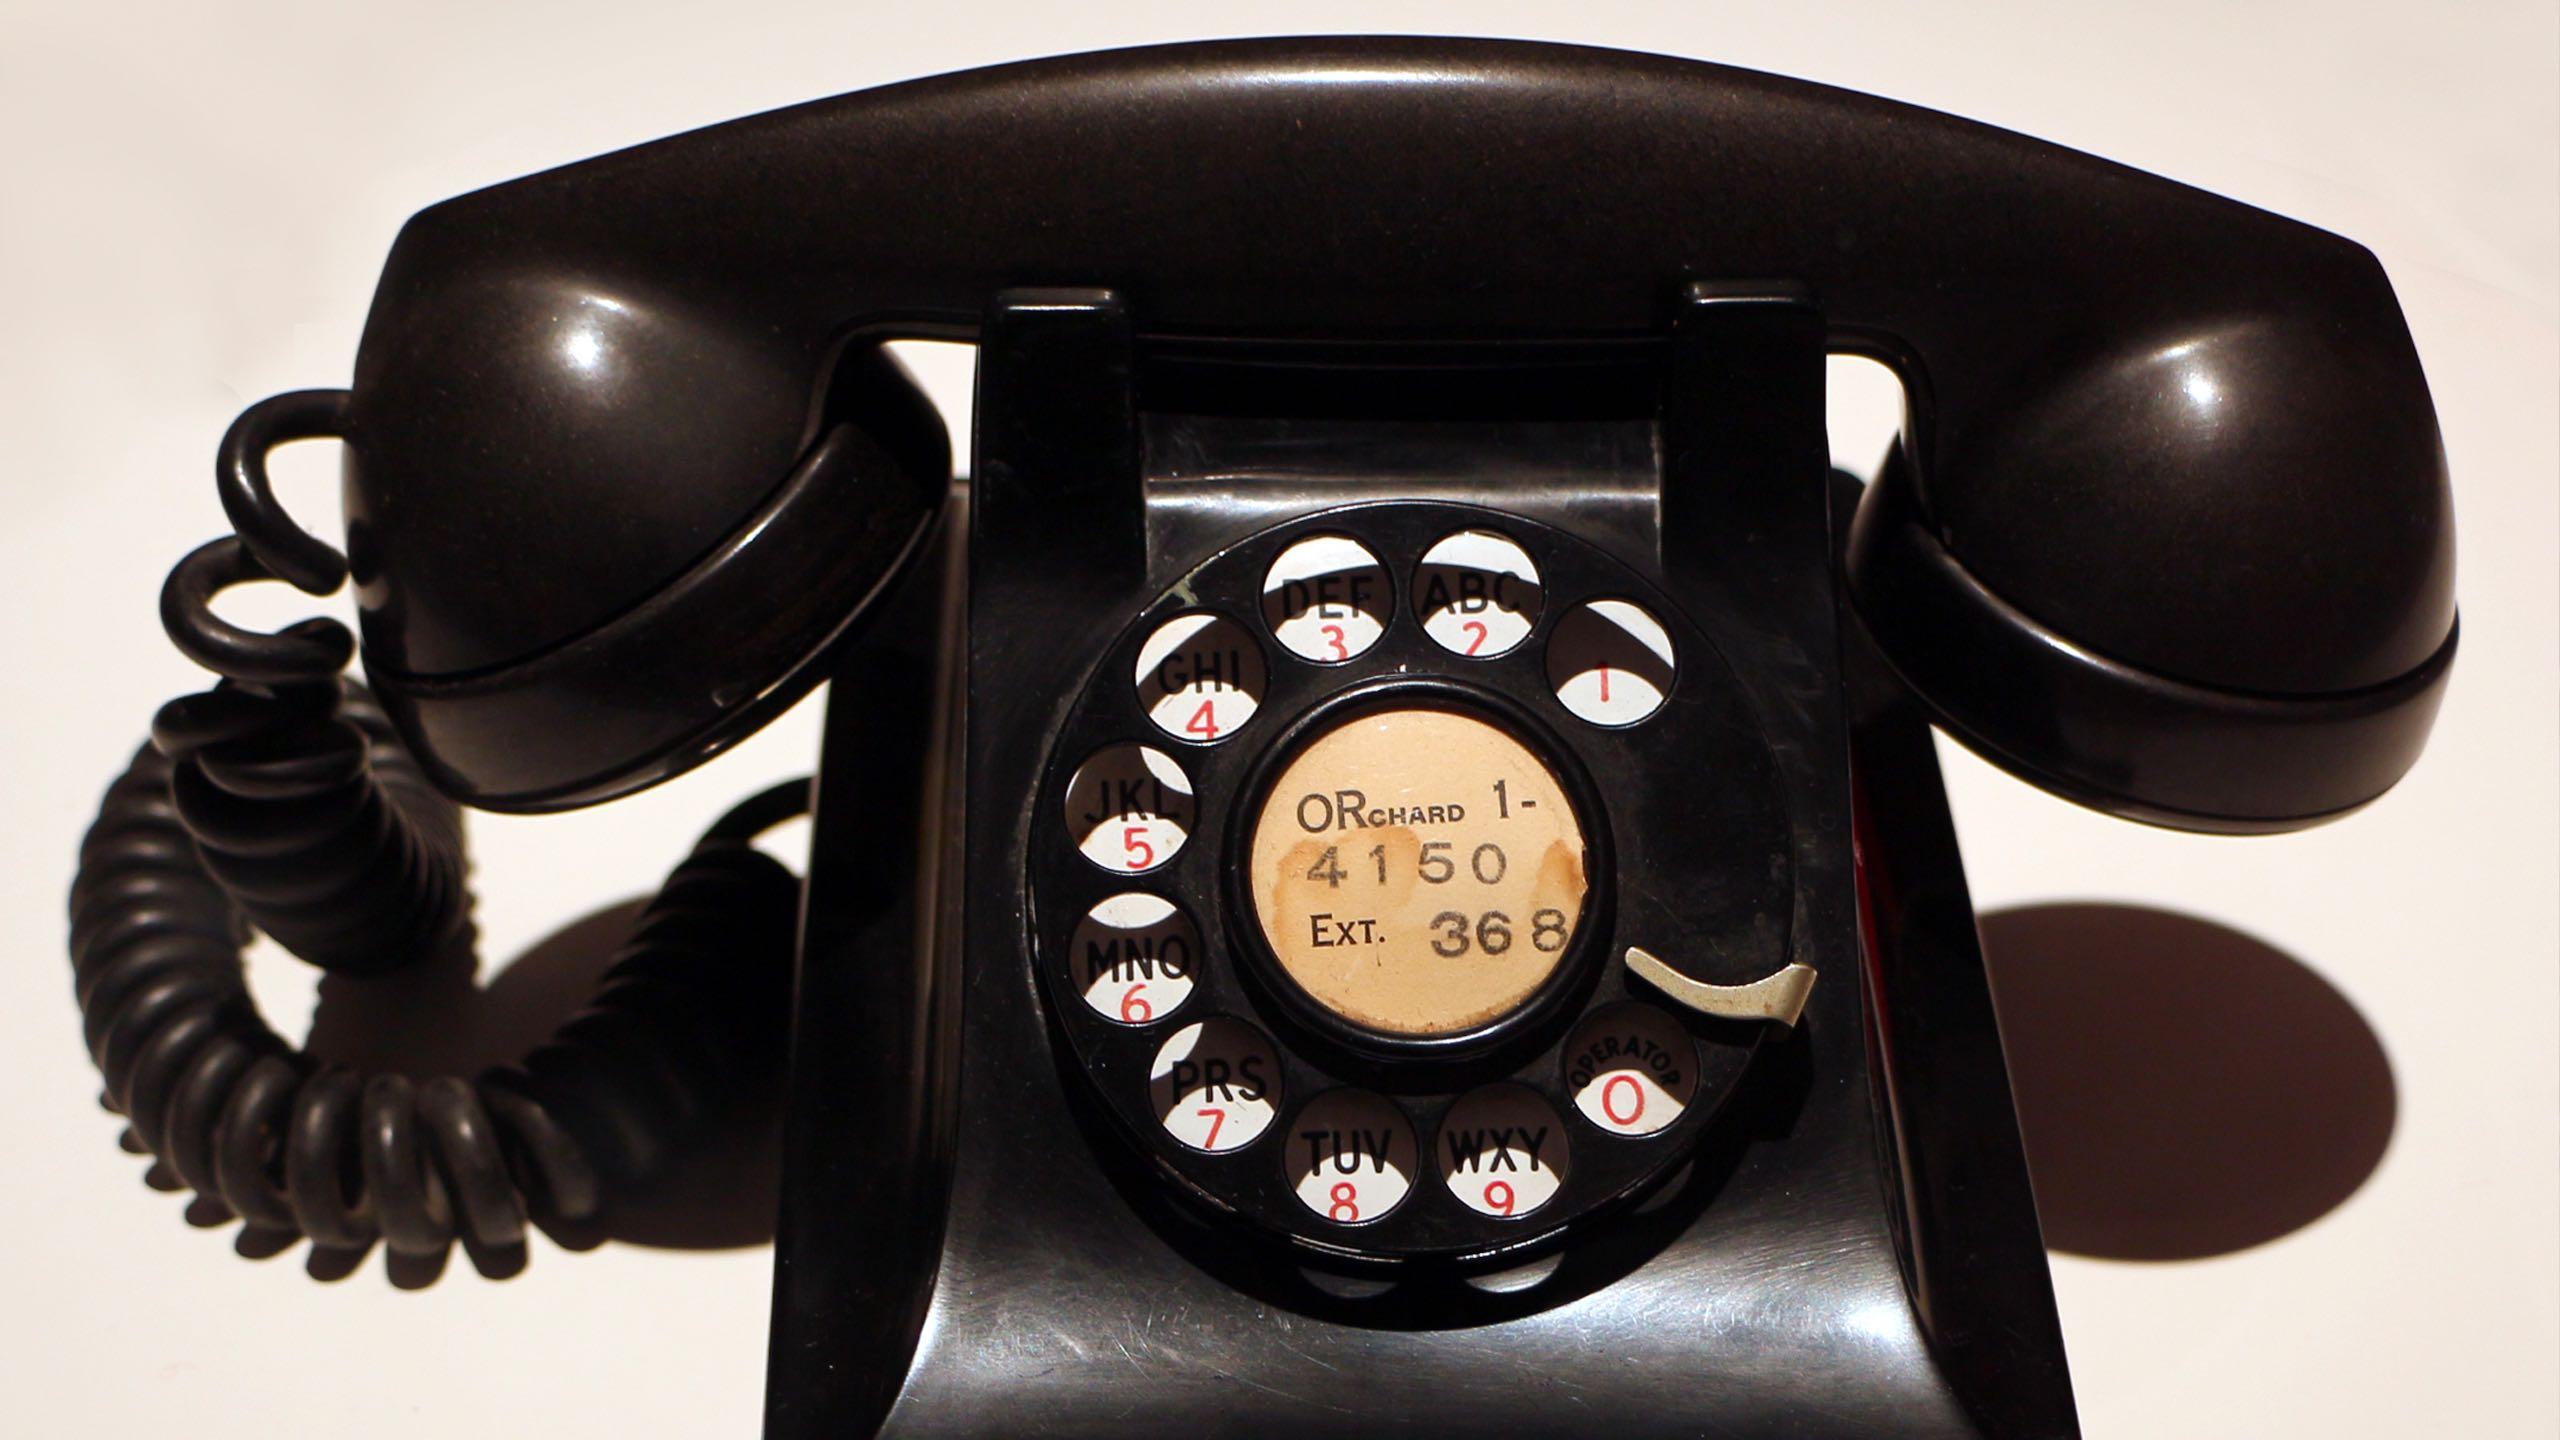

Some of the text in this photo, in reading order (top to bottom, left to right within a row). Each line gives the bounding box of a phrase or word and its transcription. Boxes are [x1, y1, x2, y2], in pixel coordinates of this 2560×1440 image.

[1281, 571, 1374, 620] DEF
[1421, 570, 1521, 615] ABC
[1320, 625, 1348, 662] 3
[1463, 620, 1488, 656] 2
[1157, 651, 1240, 694] GHI
[1186, 700, 1219, 740] 4
[1084, 778, 1180, 824] JKL
[1123, 827, 1154, 869] 5
[1429, 908, 1569, 958] 368
[1086, 935, 1190, 985] MNO
[1121, 984, 1152, 1023] 6
[1171, 1055, 1267, 1105] PRS
[1570, 1034, 1682, 1088] OPERATOR
[1197, 1108, 1226, 1150] 7
[1446, 1125, 1549, 1175] WXY
[1301, 1128, 1393, 1177] TUV
[1328, 1182, 1359, 1222] 8
[1484, 1181, 1515, 1217] 9
